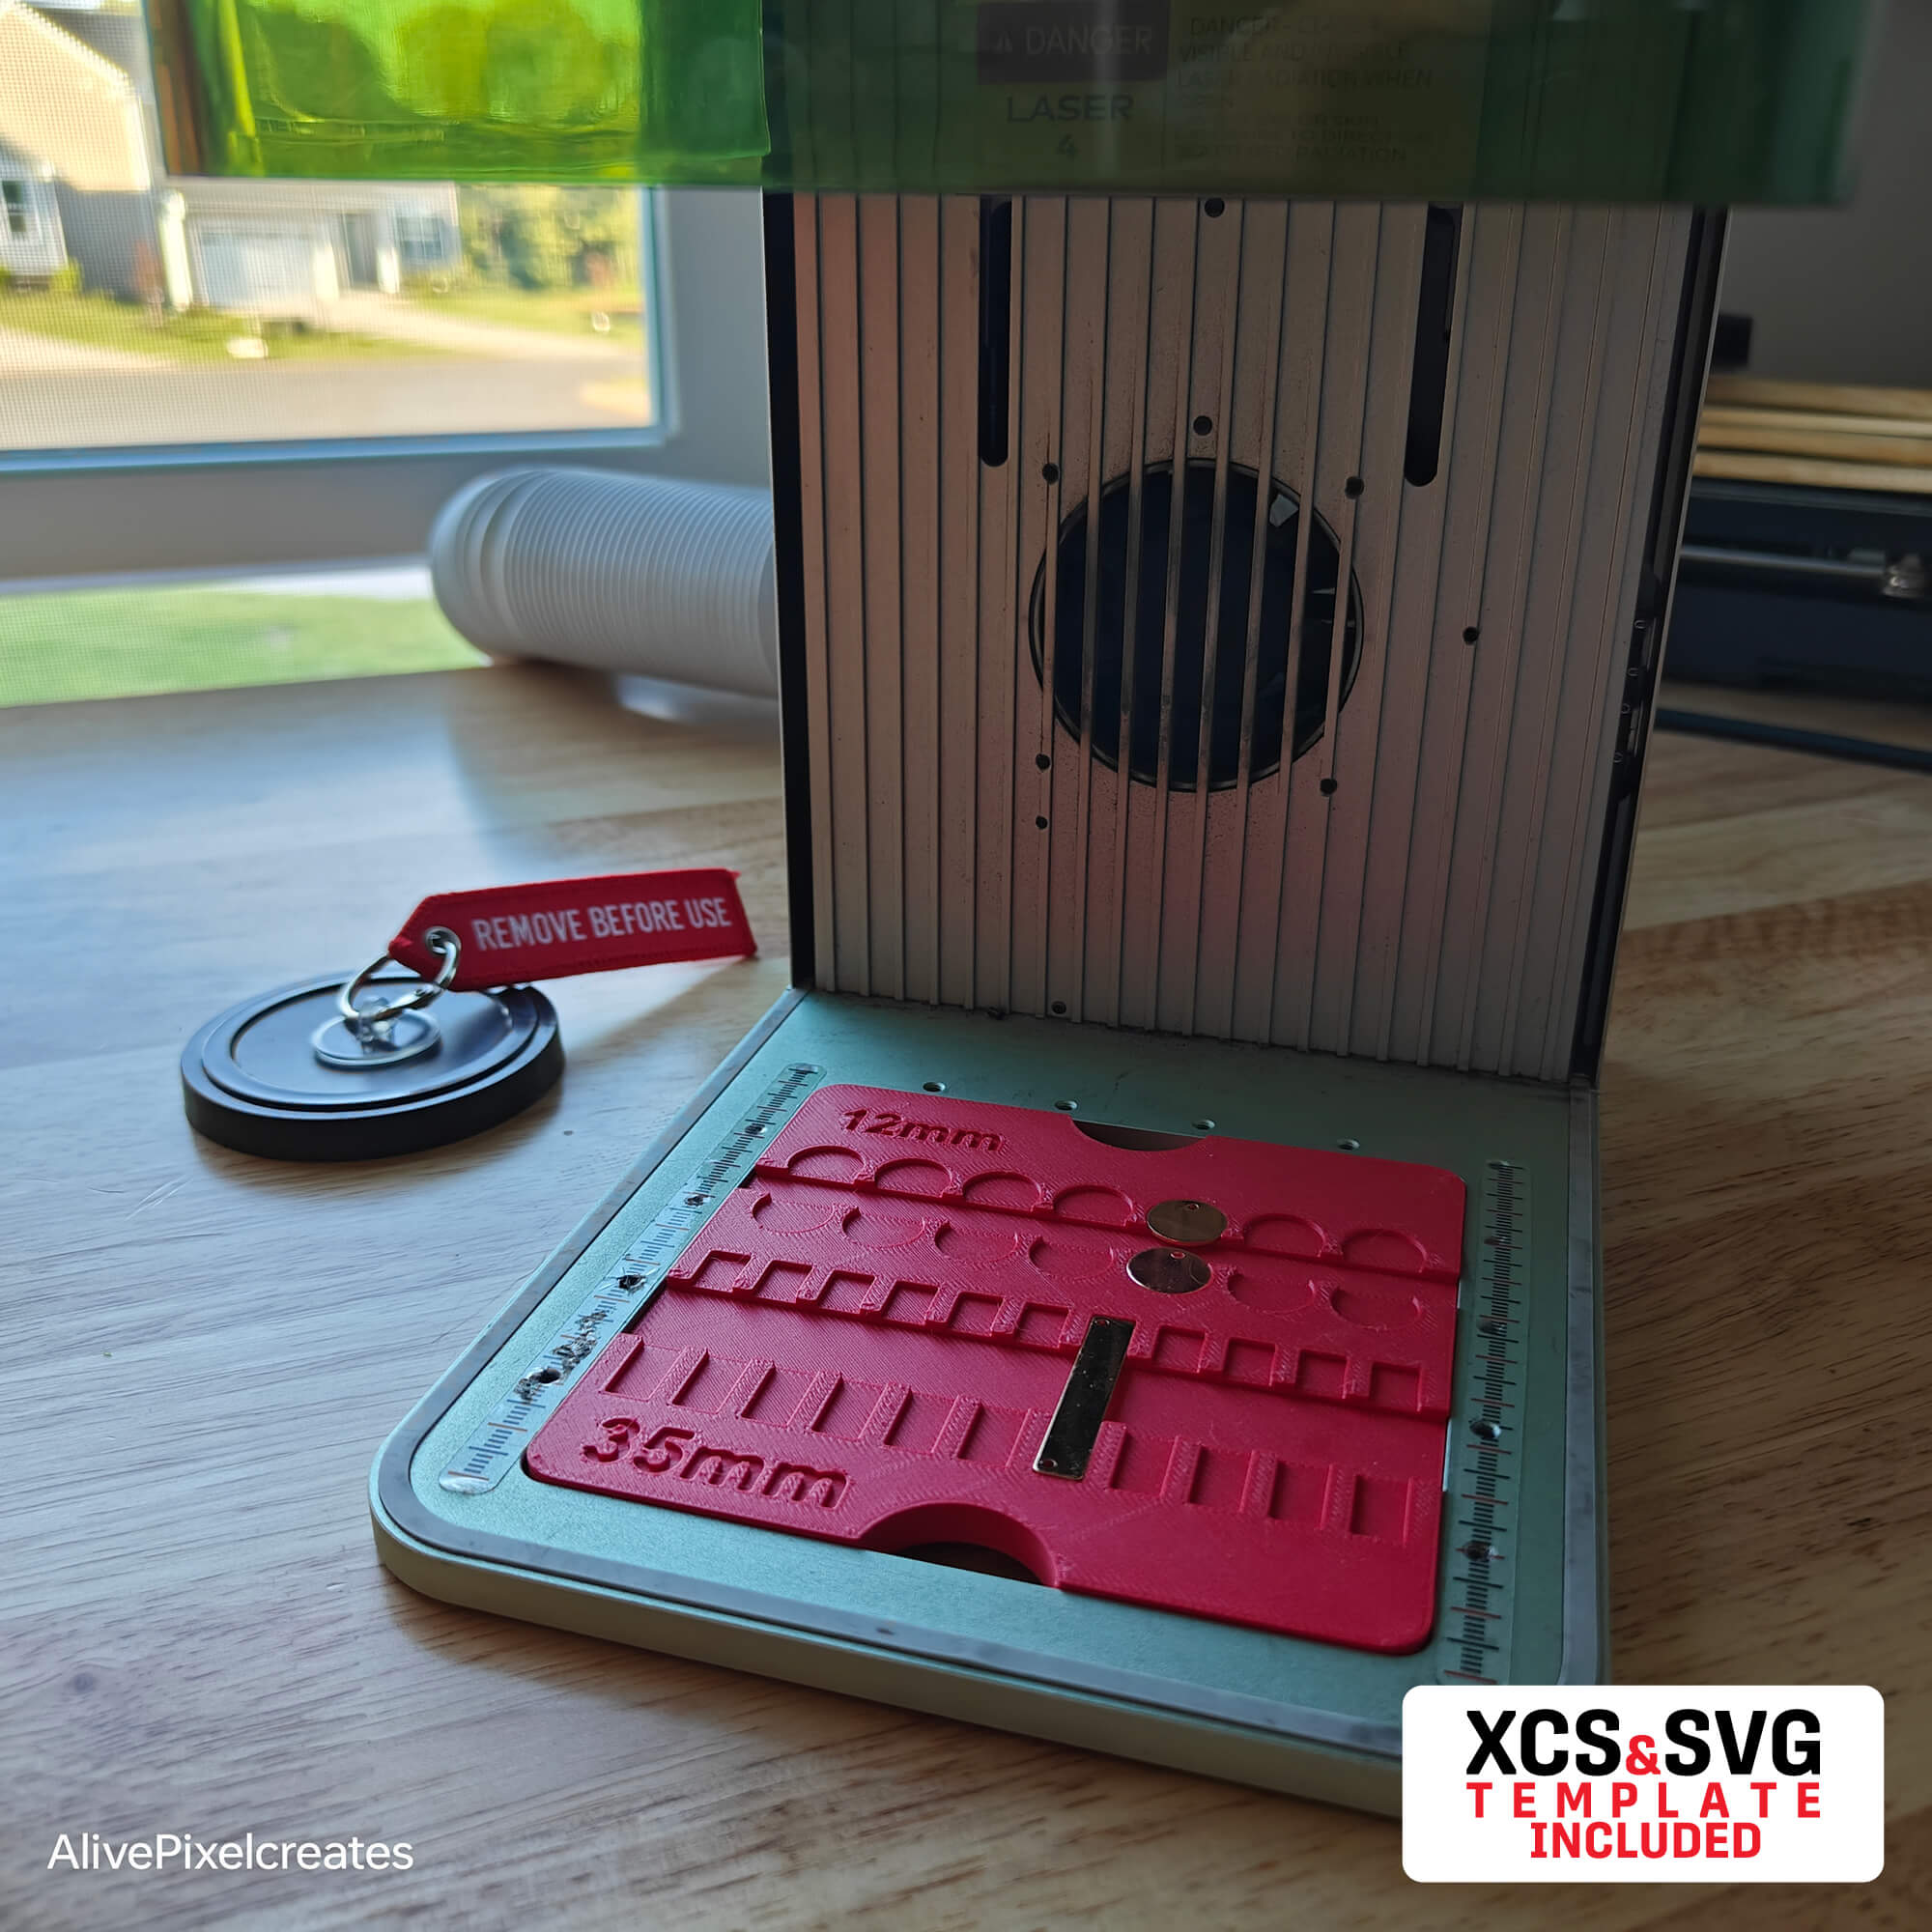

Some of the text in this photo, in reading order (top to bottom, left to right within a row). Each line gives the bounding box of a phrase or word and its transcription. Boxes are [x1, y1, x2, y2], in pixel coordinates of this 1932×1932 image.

[1025, 24, 1152, 55] DANGER
[1006, 94, 1135, 124] LASER
[471, 896, 731, 952] REMOVE BEFORE USE
[842, 1108, 1006, 1151] 12mm
[582, 1417, 850, 1510] 35mm
